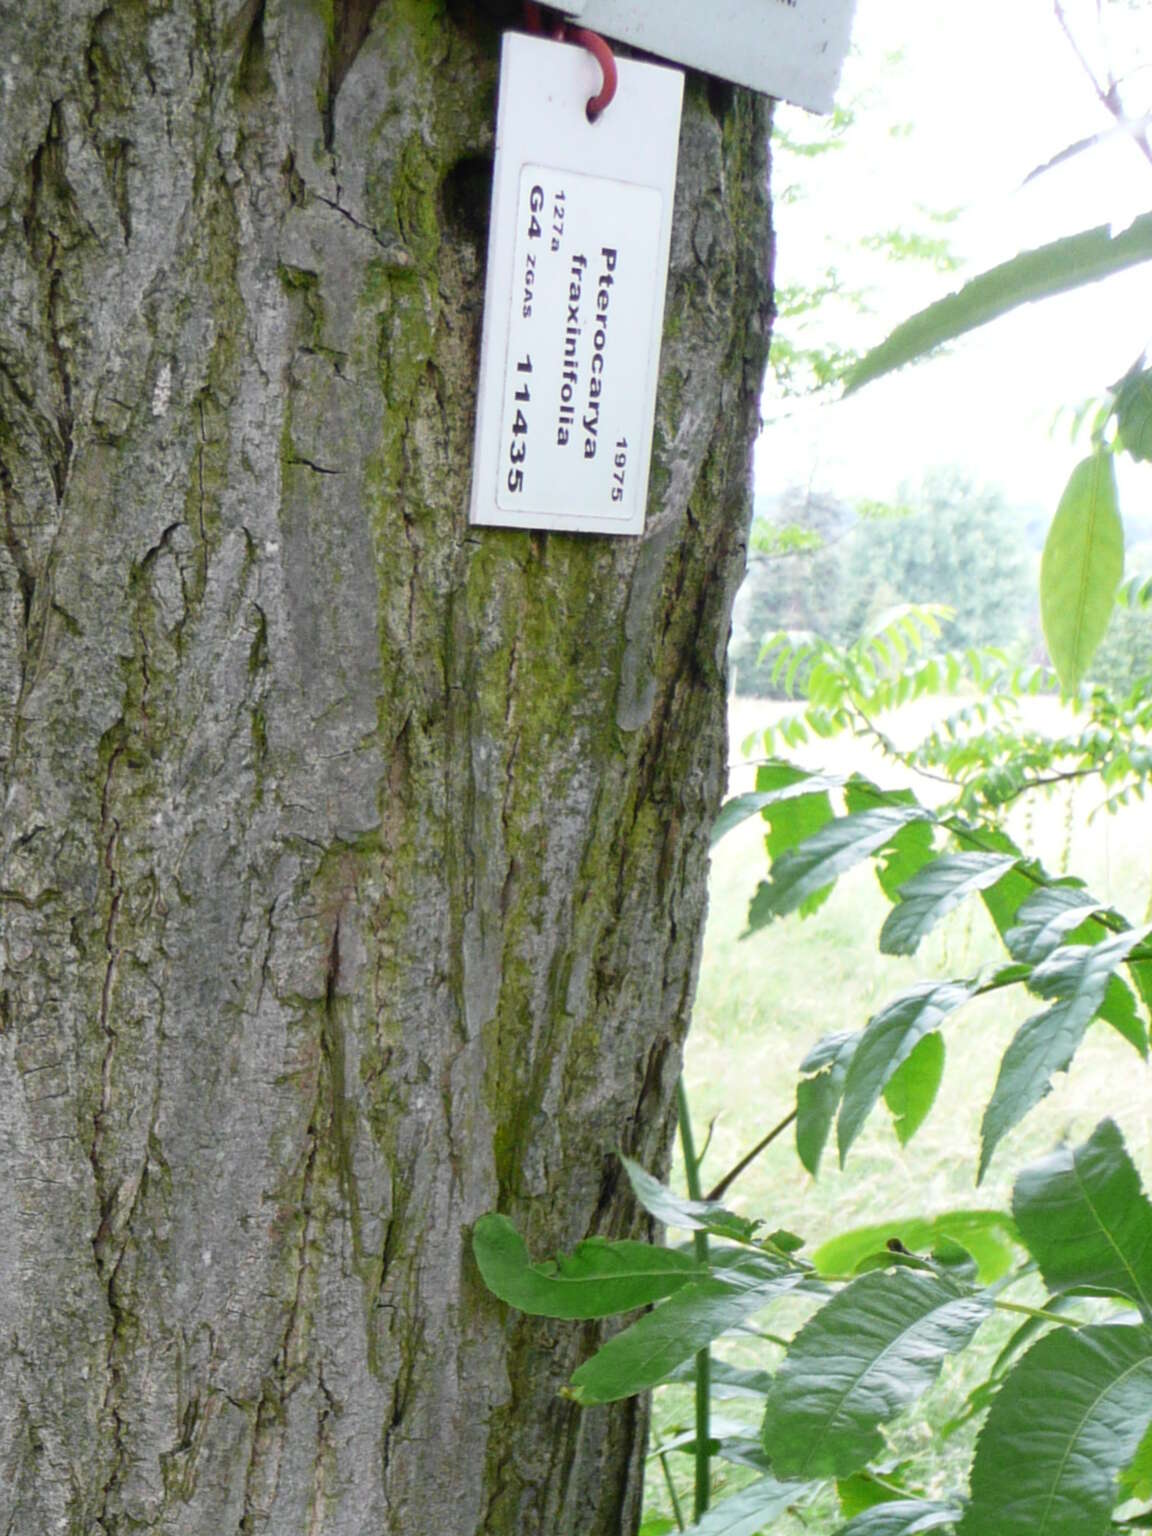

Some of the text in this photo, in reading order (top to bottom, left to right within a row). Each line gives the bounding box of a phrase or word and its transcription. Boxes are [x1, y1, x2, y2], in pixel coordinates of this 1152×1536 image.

[551, 191, 565, 251] 127a
[508, 185, 544, 492] G4 ZGAS 11435
[557, 255, 587, 445] fraxinifolia
[583, 248, 617, 459] Pterocarya
[612, 438, 627, 501] 1975
